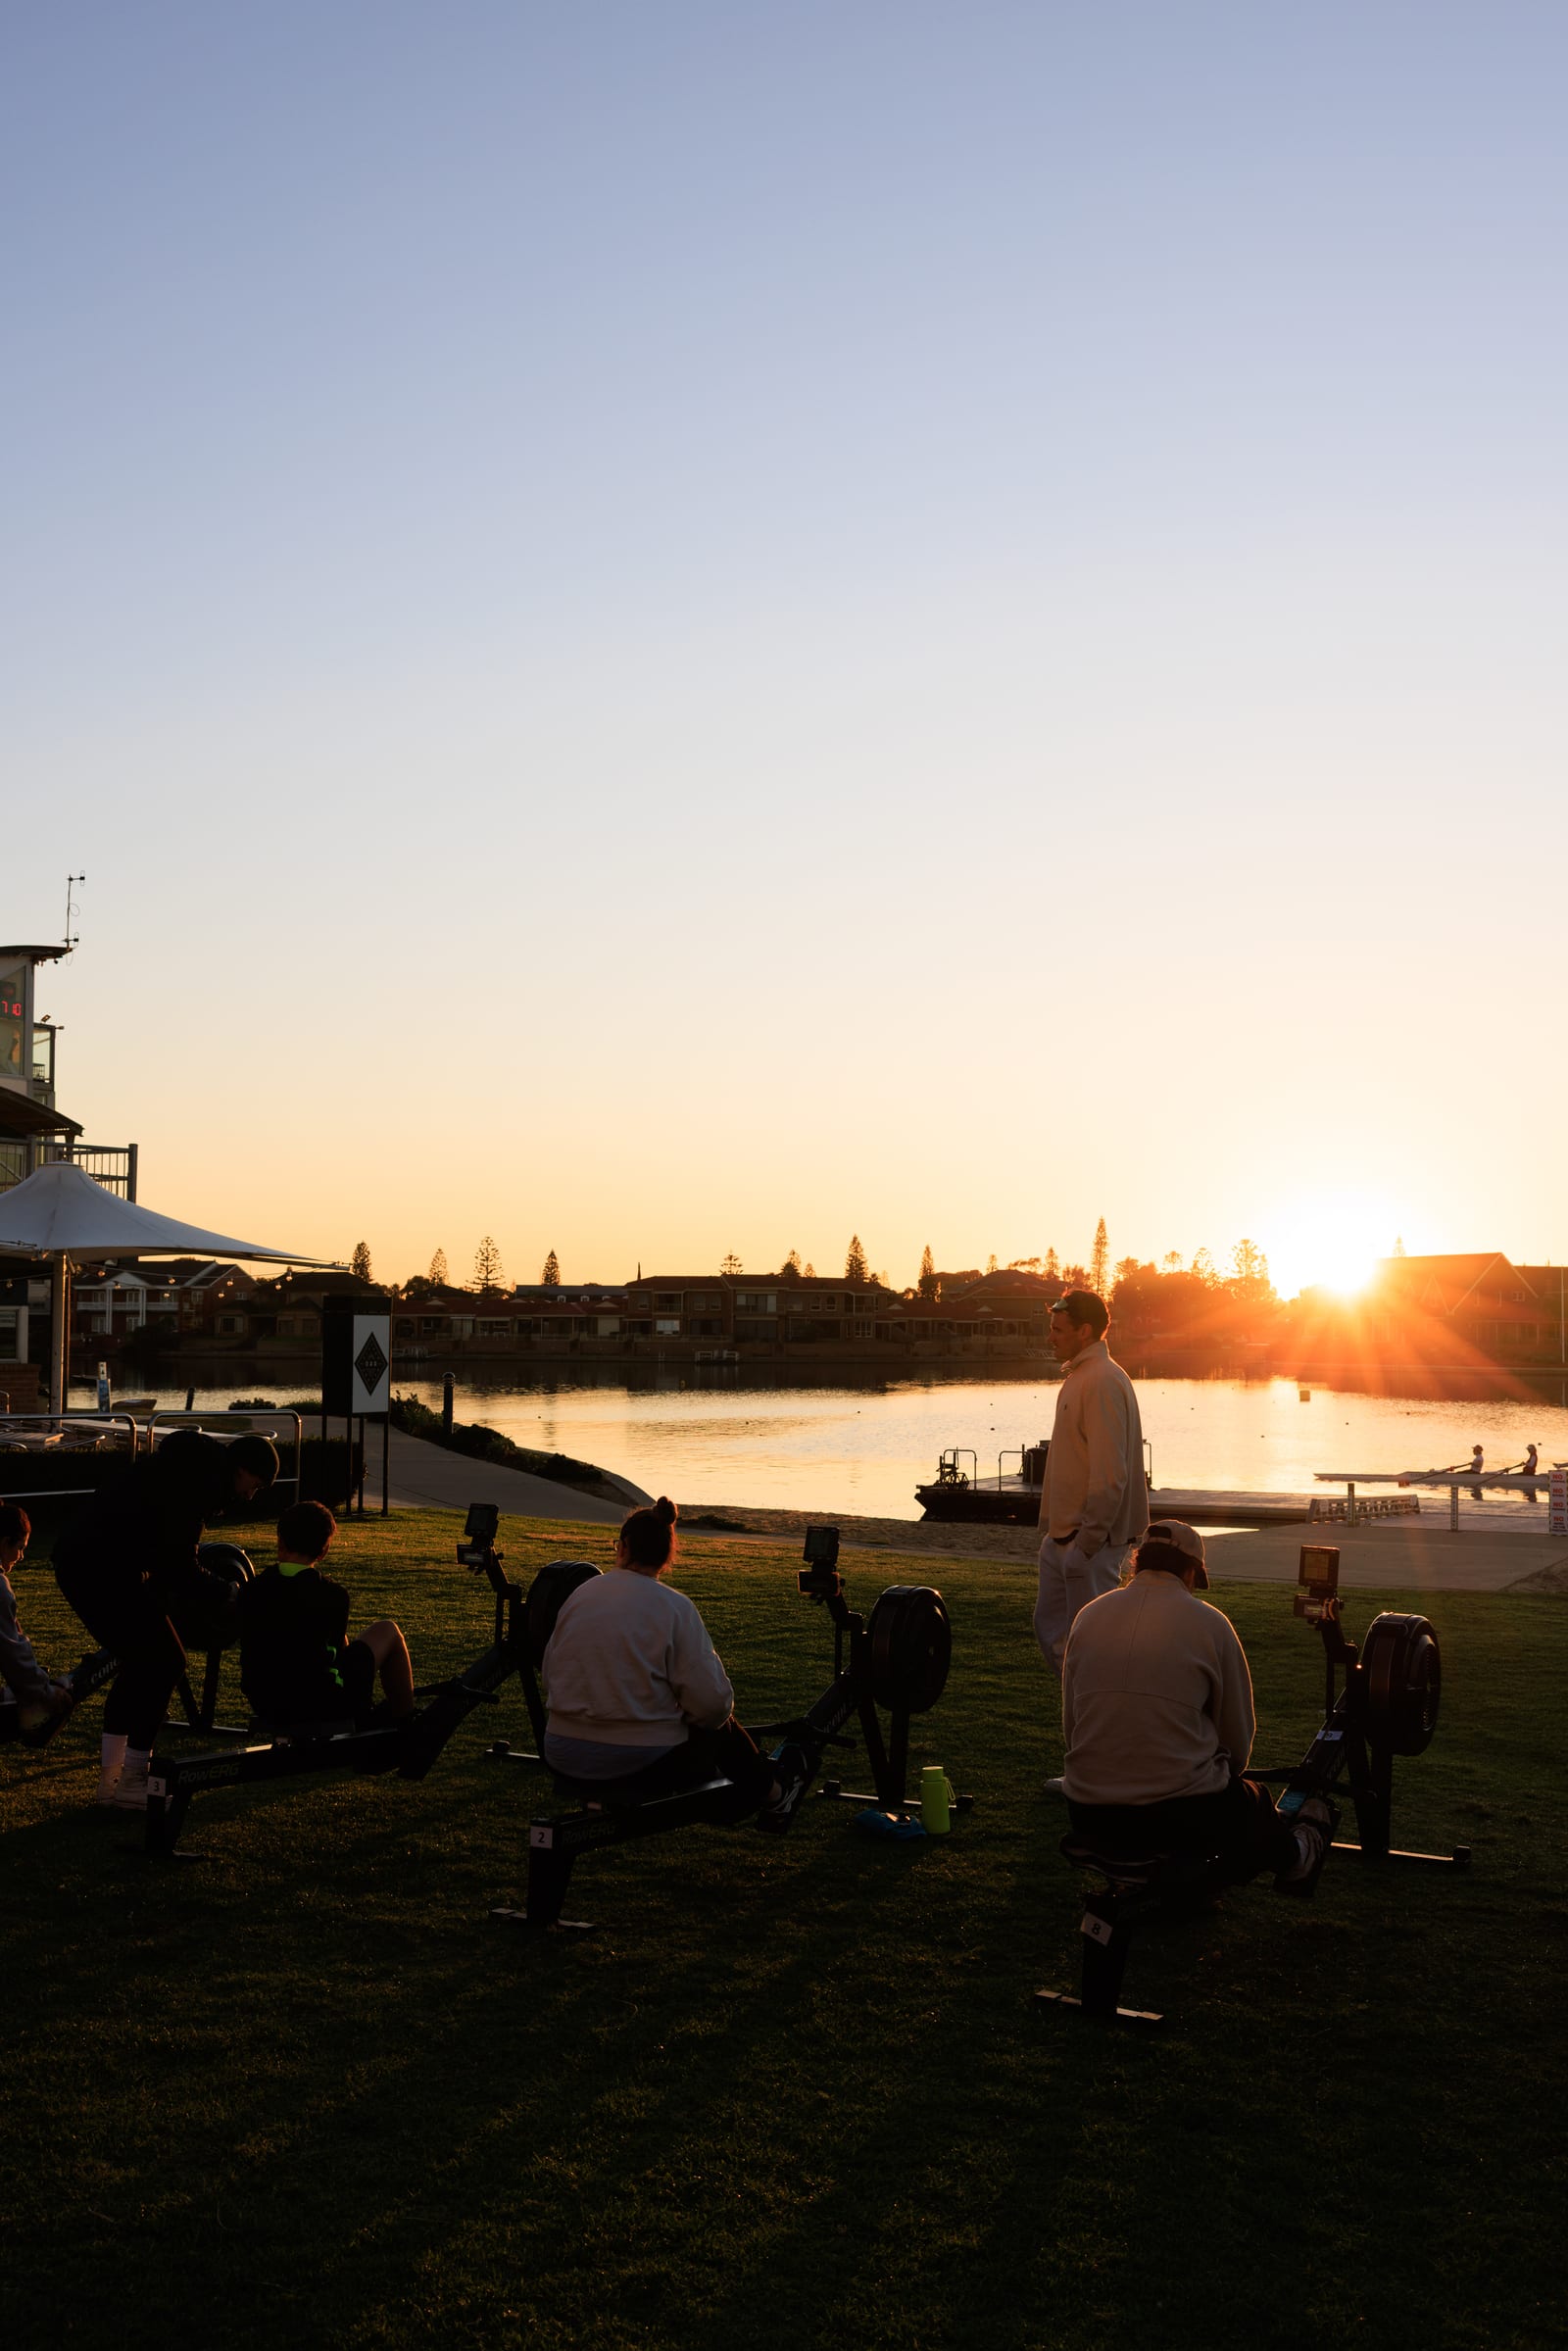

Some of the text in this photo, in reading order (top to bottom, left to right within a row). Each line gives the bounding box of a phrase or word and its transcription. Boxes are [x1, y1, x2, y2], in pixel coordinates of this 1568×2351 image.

[153, 1781, 160, 1791] 3
[538, 1832, 545, 1843] 2
[1092, 1923, 1102, 1935] 8
